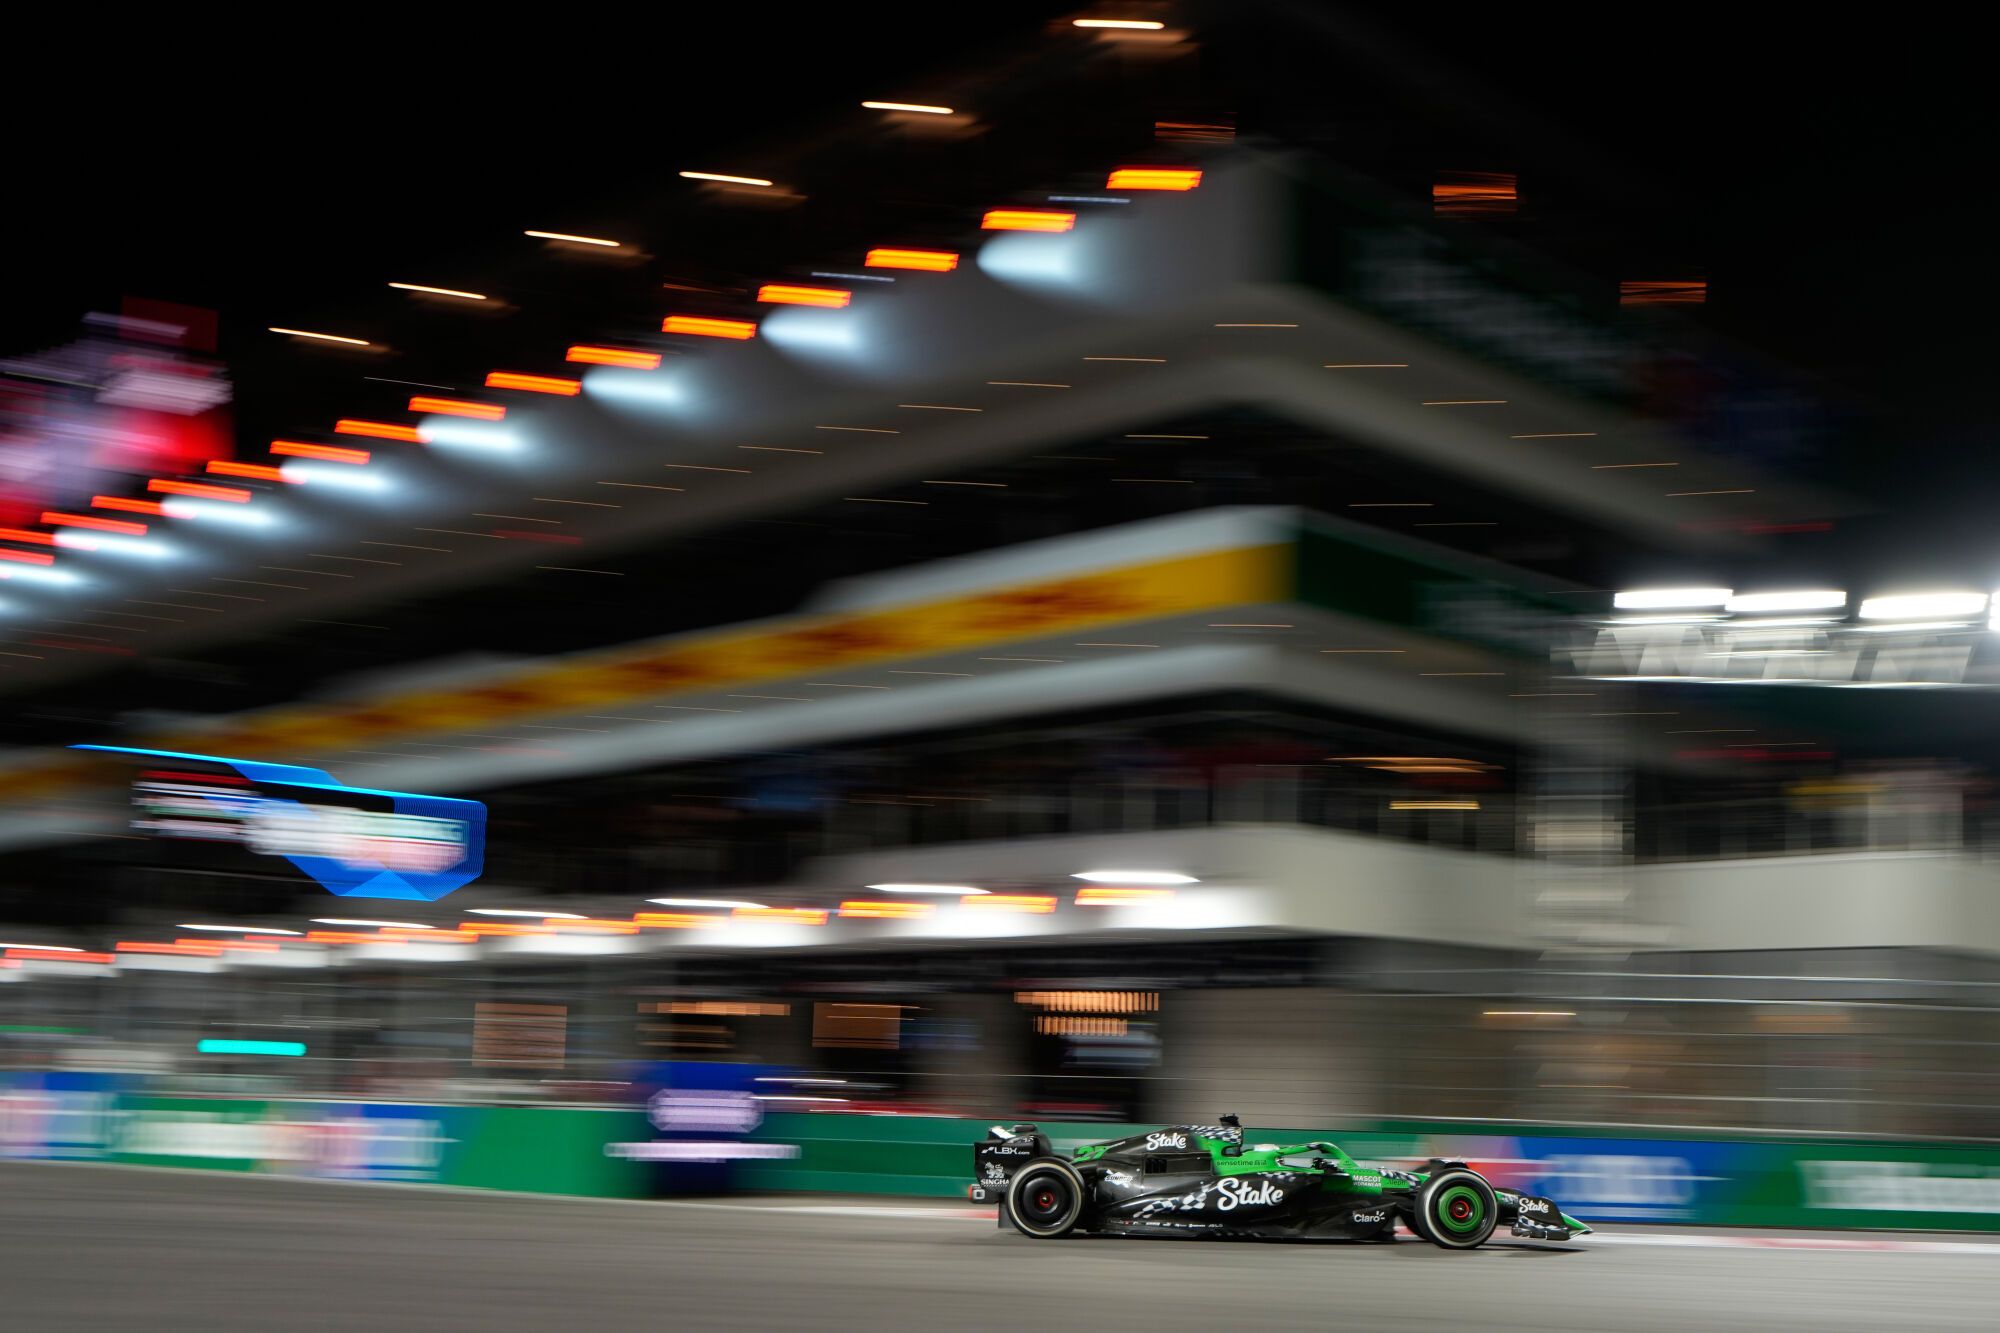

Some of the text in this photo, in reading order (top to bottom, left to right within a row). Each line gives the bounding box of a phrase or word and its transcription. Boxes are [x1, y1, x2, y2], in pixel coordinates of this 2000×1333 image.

[1145, 1132, 1187, 1151] Stake
[1074, 1145, 1109, 1162] 27
[1352, 1175, 1382, 1183] MASCOT
[1216, 1177, 1284, 1211] Stake
[1518, 1197, 1550, 1214] Stake
[1353, 1213, 1381, 1223] Claro
